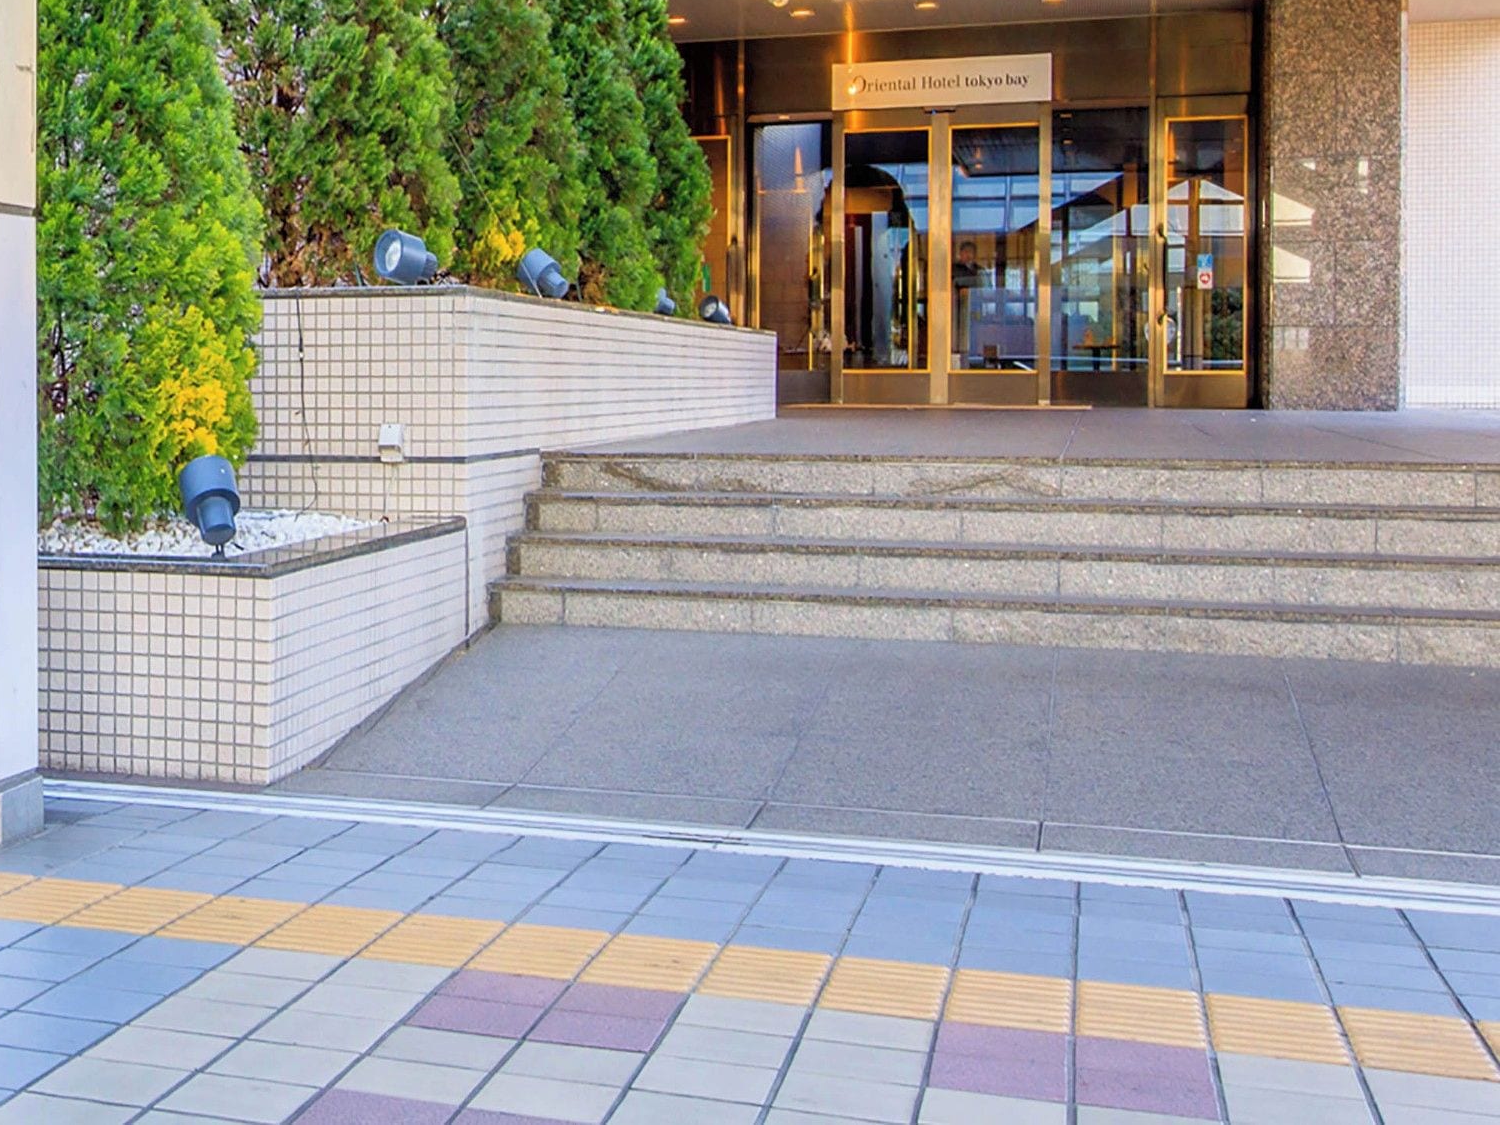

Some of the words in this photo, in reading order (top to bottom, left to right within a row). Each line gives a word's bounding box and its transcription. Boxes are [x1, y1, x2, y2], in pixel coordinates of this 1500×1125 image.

[850, 75, 916, 93] Oriental
[921, 74, 961, 90] Hotel
[965, 74, 1001, 88] tokyo
[1005, 73, 1030, 87] bay
